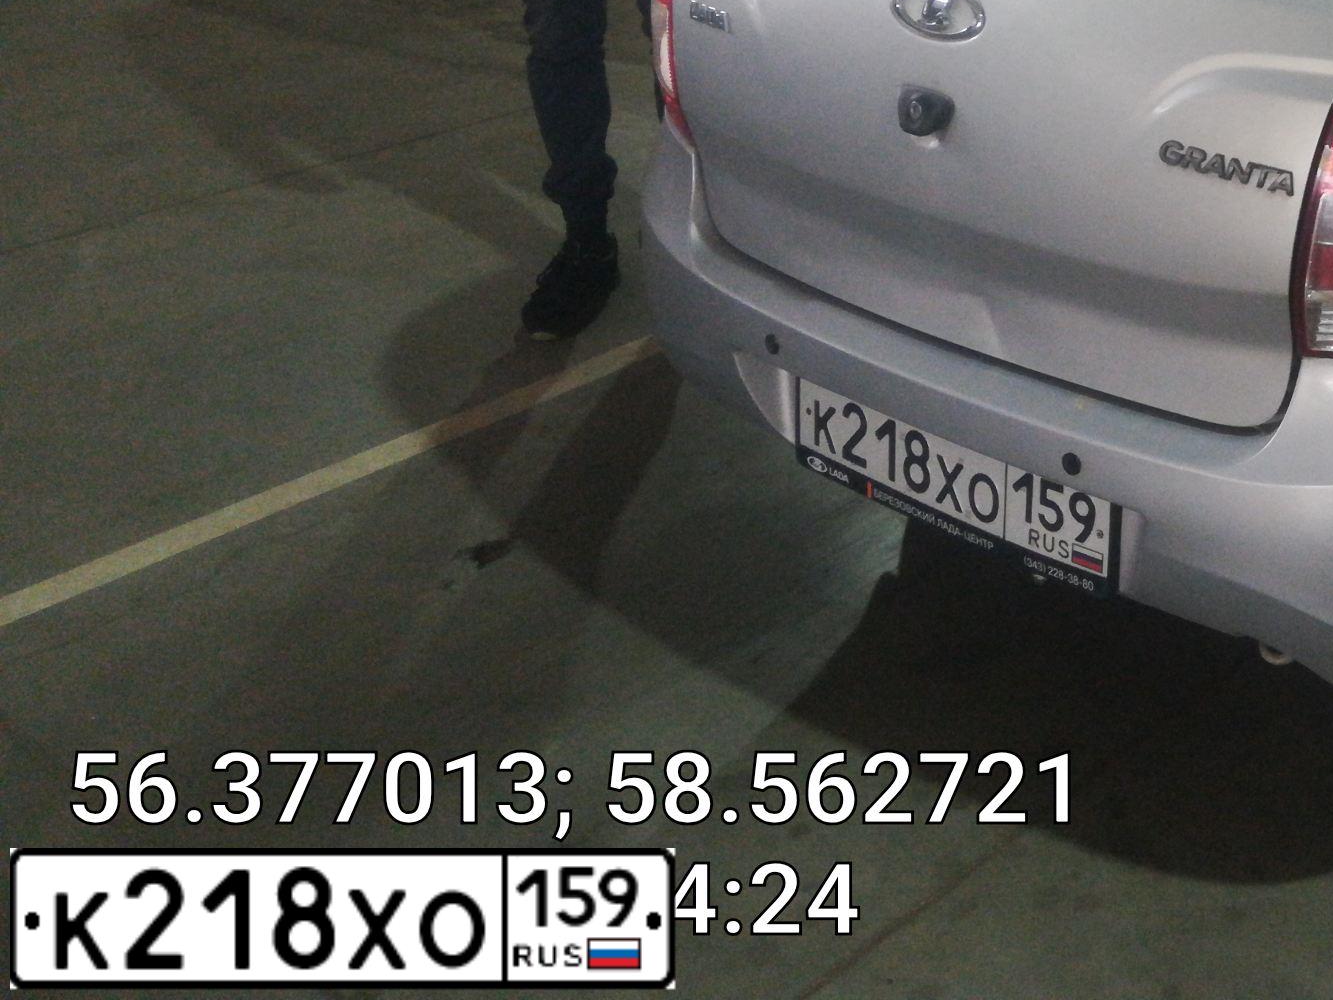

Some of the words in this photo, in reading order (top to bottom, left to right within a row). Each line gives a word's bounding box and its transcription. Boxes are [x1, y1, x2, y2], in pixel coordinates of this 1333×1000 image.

[1158, 139, 1295, 197] GRANTA
[829, 467, 850, 484] LADA
[1012, 472, 1097, 543] 159
[1028, 528, 1070, 559] RUS
